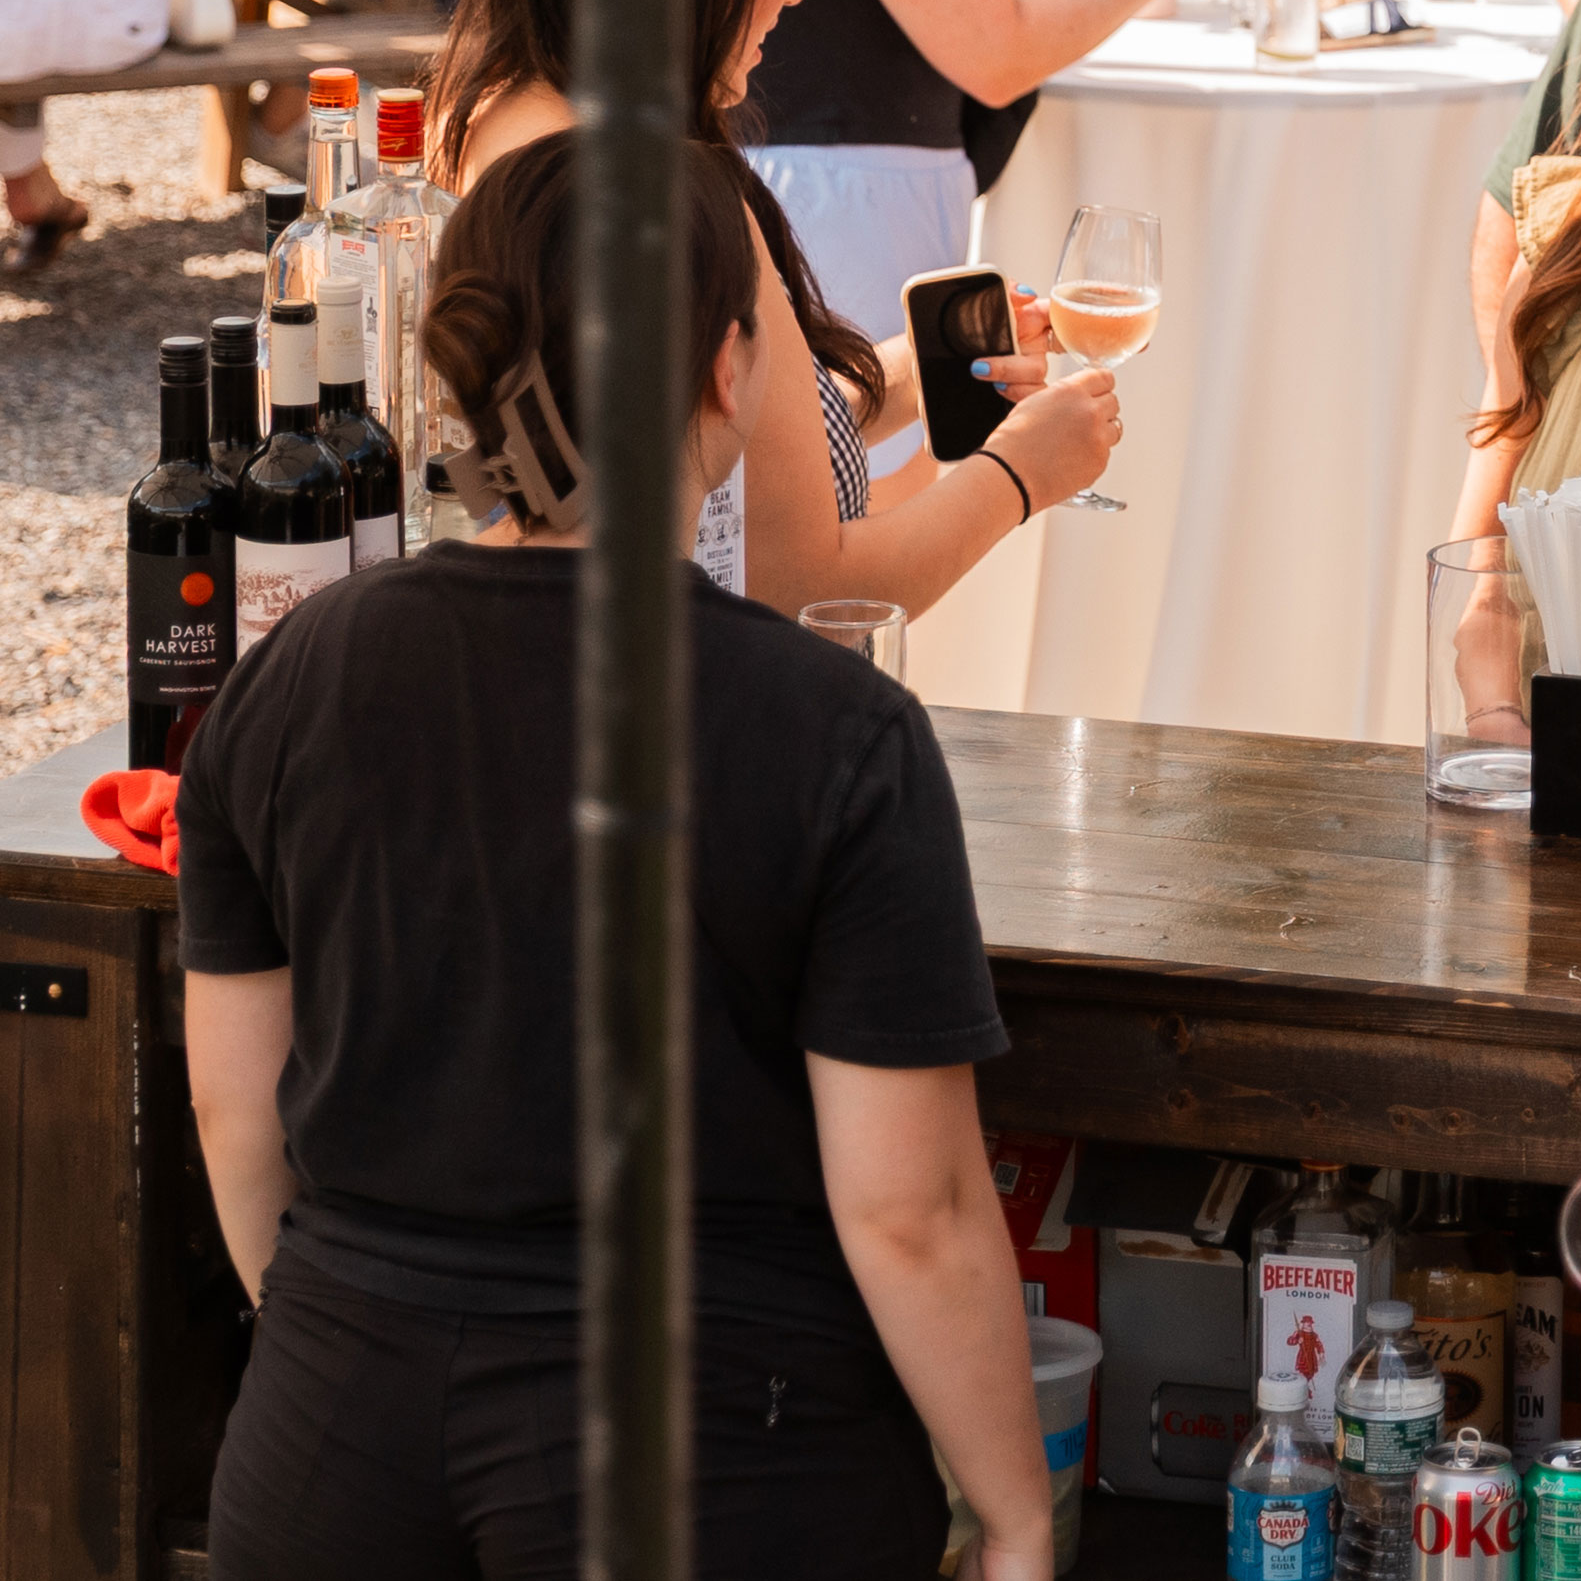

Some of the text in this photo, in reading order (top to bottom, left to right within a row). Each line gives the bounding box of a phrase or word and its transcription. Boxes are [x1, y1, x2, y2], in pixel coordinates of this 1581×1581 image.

[710, 489, 731, 505] BEAM
[707, 502, 733, 518] FAMILY
[171, 623, 217, 638] DARK
[145, 638, 217, 654] HARVEST
[139, 656, 217, 666] CABERNET SAUVIGNON
[1263, 1264, 1356, 1298] BEEFEATER
[1286, 1289, 1331, 1300] LONDON
[1163, 1410, 1226, 1439] Coke
[1475, 1480, 1518, 1506] Diet
[1256, 1517, 1310, 1529] CANADA
[1412, 1491, 1526, 1558] oke
[1270, 1529, 1297, 1540] DRY
[1270, 1554, 1296, 1563] CLUB
[1270, 1562, 1296, 1571] SODA
